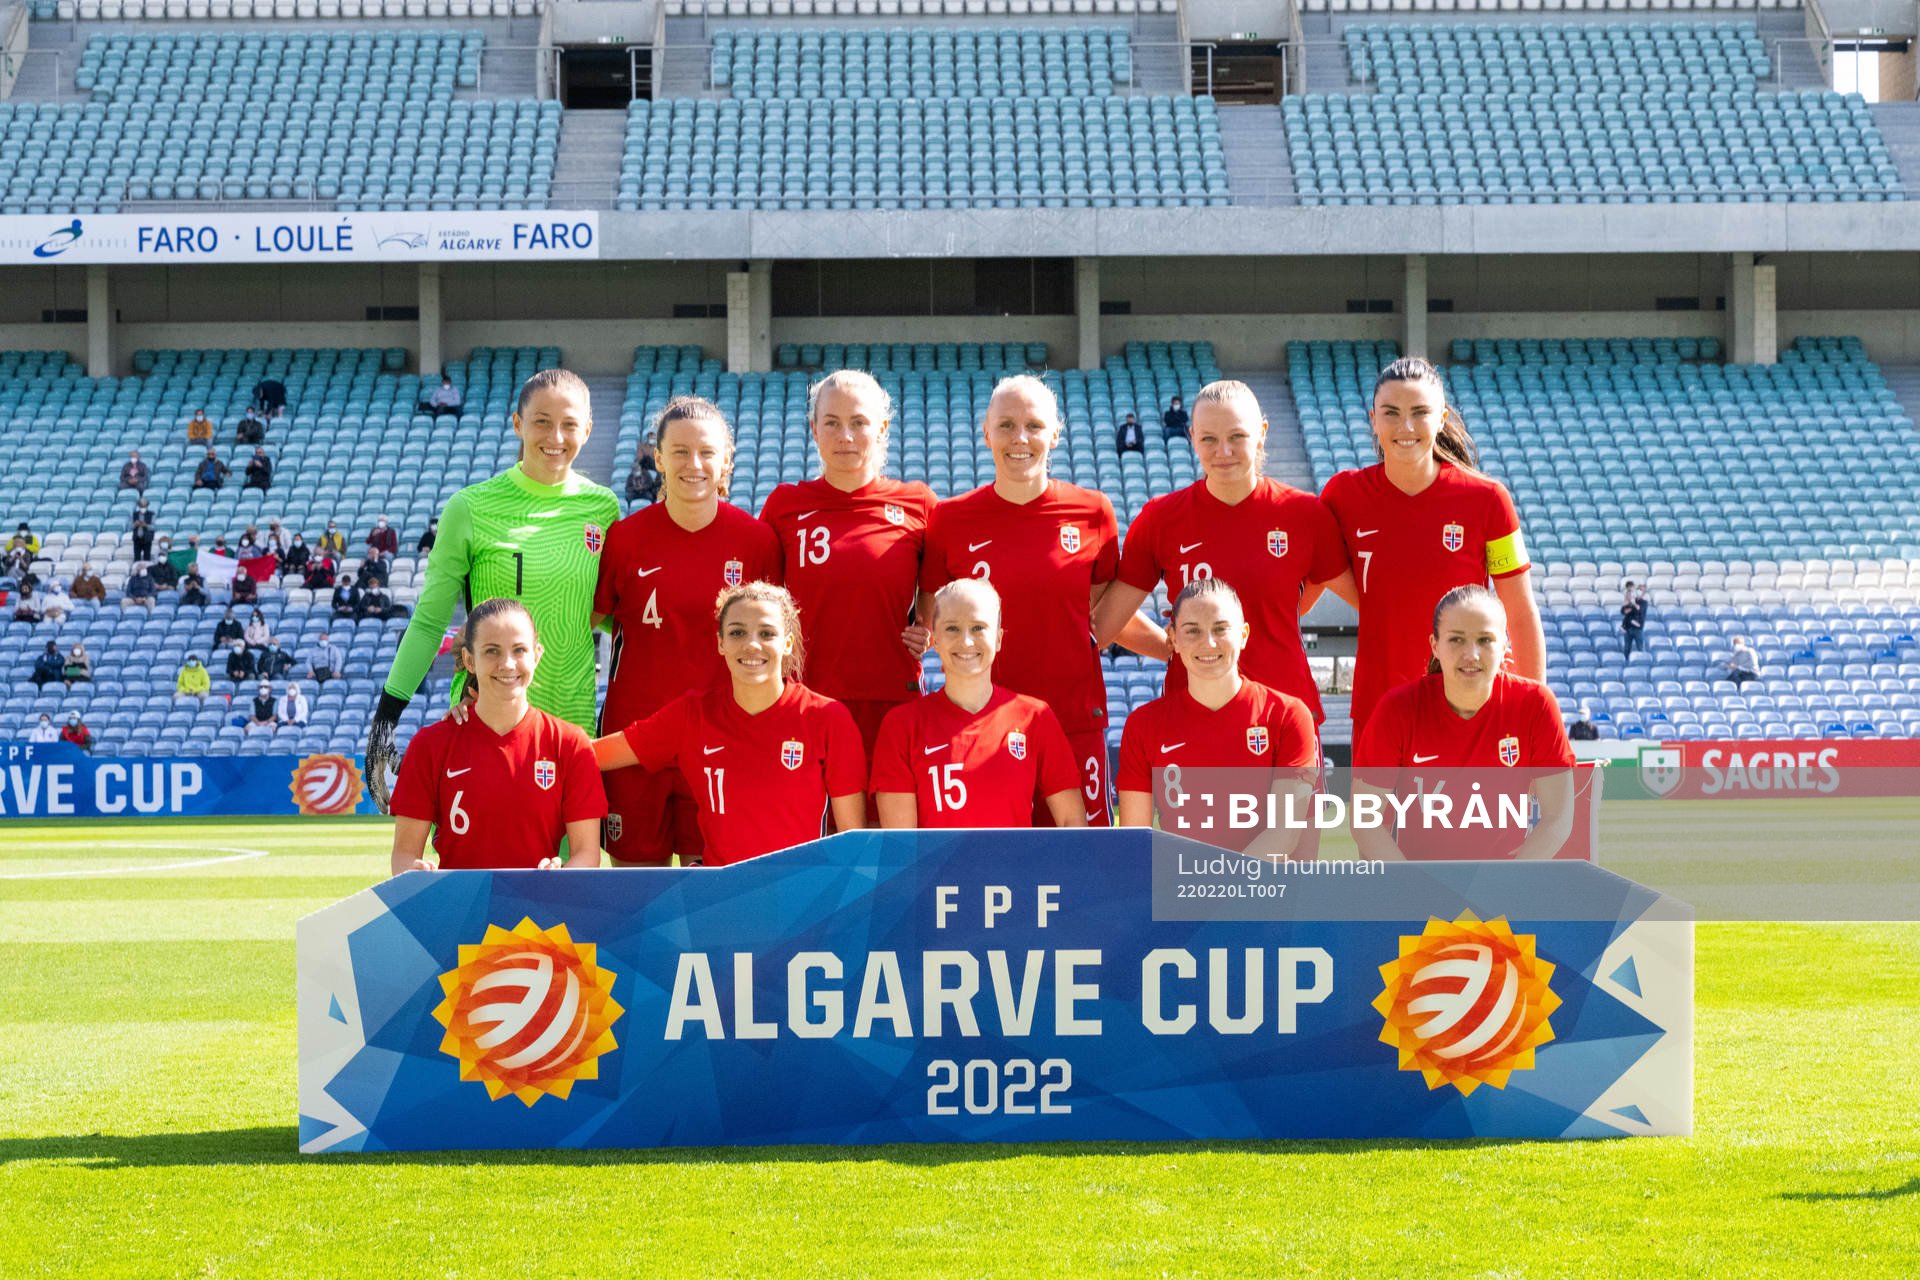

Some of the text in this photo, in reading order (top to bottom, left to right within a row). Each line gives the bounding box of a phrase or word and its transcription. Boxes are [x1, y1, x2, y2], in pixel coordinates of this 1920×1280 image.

[138, 217, 353, 253] FARO LOULÉ
[439, 238, 502, 250] ALGARVE
[513, 222, 593, 250] FARO
[796, 526, 831, 568] 13
[512, 552, 523, 596] 1
[1357, 551, 1373, 593] 7
[642, 587, 663, 630] 4
[0, 745, 34, 761] PF
[1701, 748, 1840, 794] SAGRES
[95, 762, 203, 814] CUP
[703, 766, 725, 814] 11
[927, 763, 967, 812] 15
[1085, 756, 1100, 800] 3
[1163, 763, 1184, 808] 8
[449, 790, 470, 835] 6
[664, 947, 1334, 1040] ALGARVE CUP
[927, 1058, 1072, 1115] 2022
